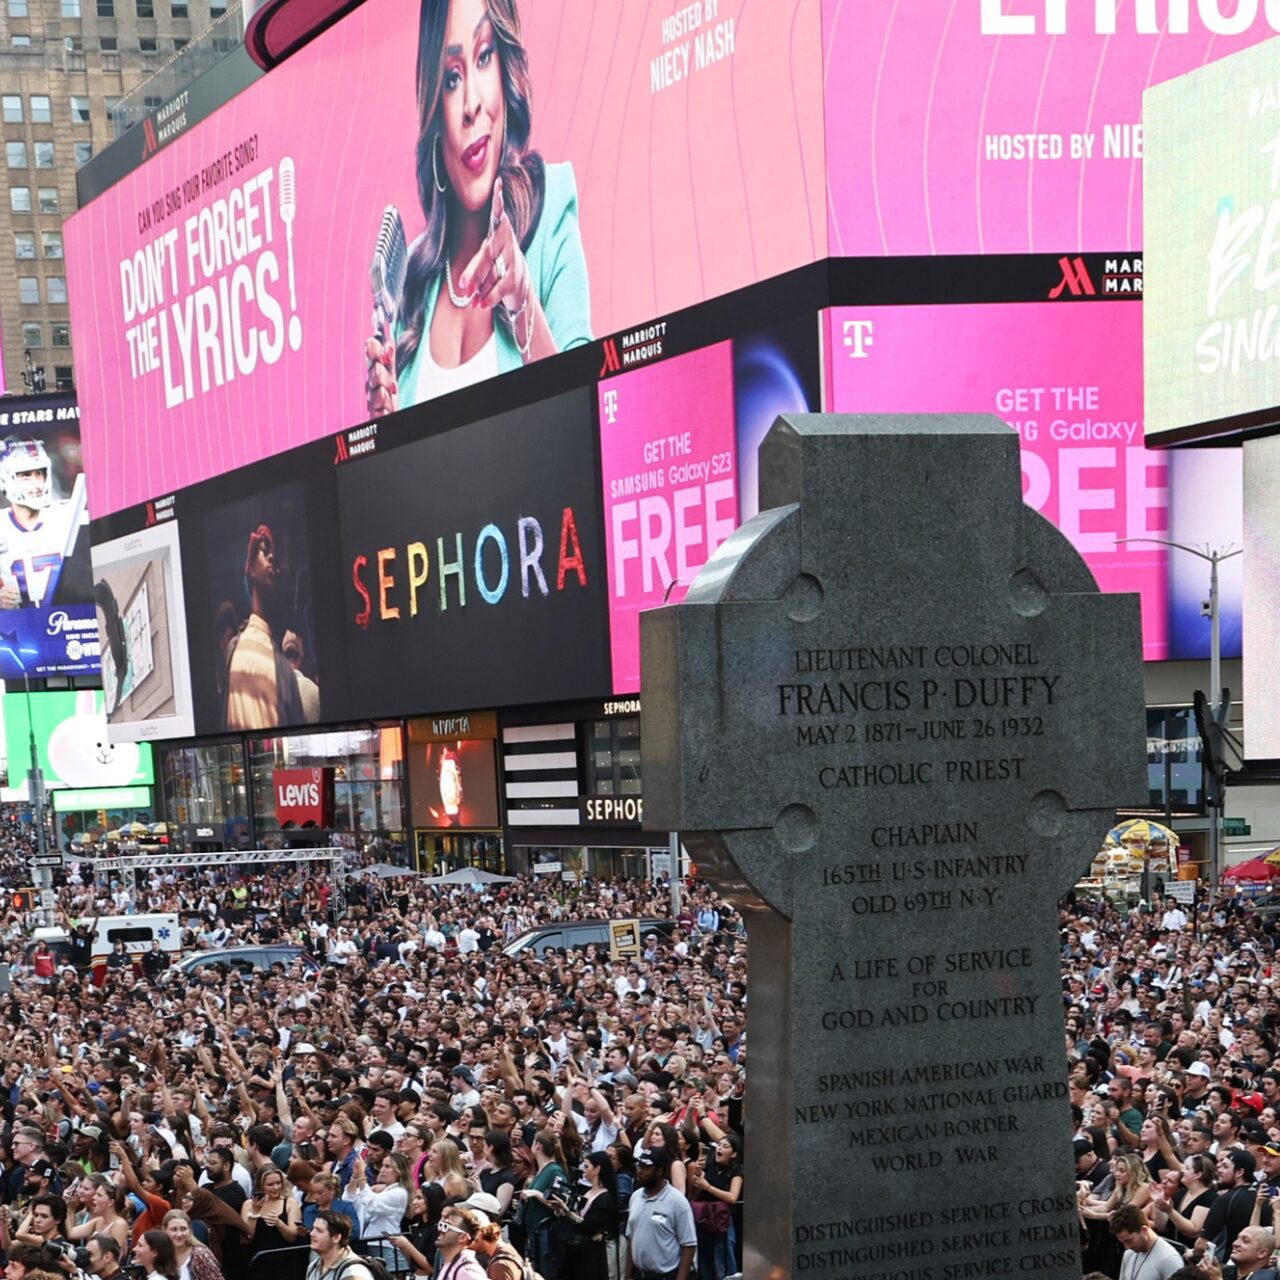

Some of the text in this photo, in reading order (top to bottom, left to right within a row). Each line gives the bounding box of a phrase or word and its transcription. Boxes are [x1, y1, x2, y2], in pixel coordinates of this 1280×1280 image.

[661, 2, 702, 45] HOSTED
[650, 20, 735, 94] NIECY NASH
[157, 91, 189, 125] MARRIOTT
[158, 113, 187, 143] MARQUIS
[985, 134, 1062, 160] HOSTED
[1070, 134, 1095, 159] BY
[138, 134, 258, 235] CAN YOU SING YOUR FAVORITE SONG?
[120, 167, 274, 324] DON'T FORGET
[126, 315, 160, 379] THE
[622, 323, 667, 348] MARRIOTT
[624, 342, 662, 364] MARQUIS
[996, 386, 1099, 413] GET THE
[12, 409, 53, 425] STARS
[1050, 419, 1137, 444] Galaxy
[348, 424, 377, 442] MARRIOTT
[349, 440, 375, 456] MARQUIS
[644, 432, 692, 464] GET THE
[611, 451, 733, 498] SAMSUNG Galaxy S23
[611, 478, 737, 597] FREE
[10, 553, 62, 607] 17
[353, 507, 588, 629] SEPHORA
[796, 644, 1038, 671] LIEUTENANT COLONEL
[604, 700, 642, 715] SEPHORA
[778, 681, 911, 715] FRANCIS
[954, 676, 1061, 708] DUFFY
[796, 725, 838, 745] MAY
[846, 724, 856, 743] 2
[974, 718, 996, 739] 26
[1002, 717, 1043, 737] 1932
[819, 758, 1025, 789] CATHOLIC PRIEST
[871, 822, 978, 848] CHAPLAIN
[822, 863, 882, 886] 165TH
[852, 896, 896, 914] OLD
[904, 891, 952, 911] 69TH
[830, 949, 1032, 982] A LIFE OF SERVICE
[912, 980, 948, 998] FOR
[821, 997, 1039, 1031] GOD AND COUNTRY
[819, 1056, 1044, 1092] SPANISH AMERICAN WAR
[794, 1081, 1068, 1125] NEW YORK NATIONAL GUARD
[848, 1115, 1019, 1148] MEXICAN BORDER
[872, 1146, 999, 1174] WORLD WAR
[795, 1195, 1074, 1244] DISTINGUISHED SERVICE CROSS
[796, 1221, 1079, 1271] DISTINGUISHED SERVICE MEDAL
[943, 1257, 1013, 1280] SERVICE
[1020, 1250, 1076, 1271] CROSS
